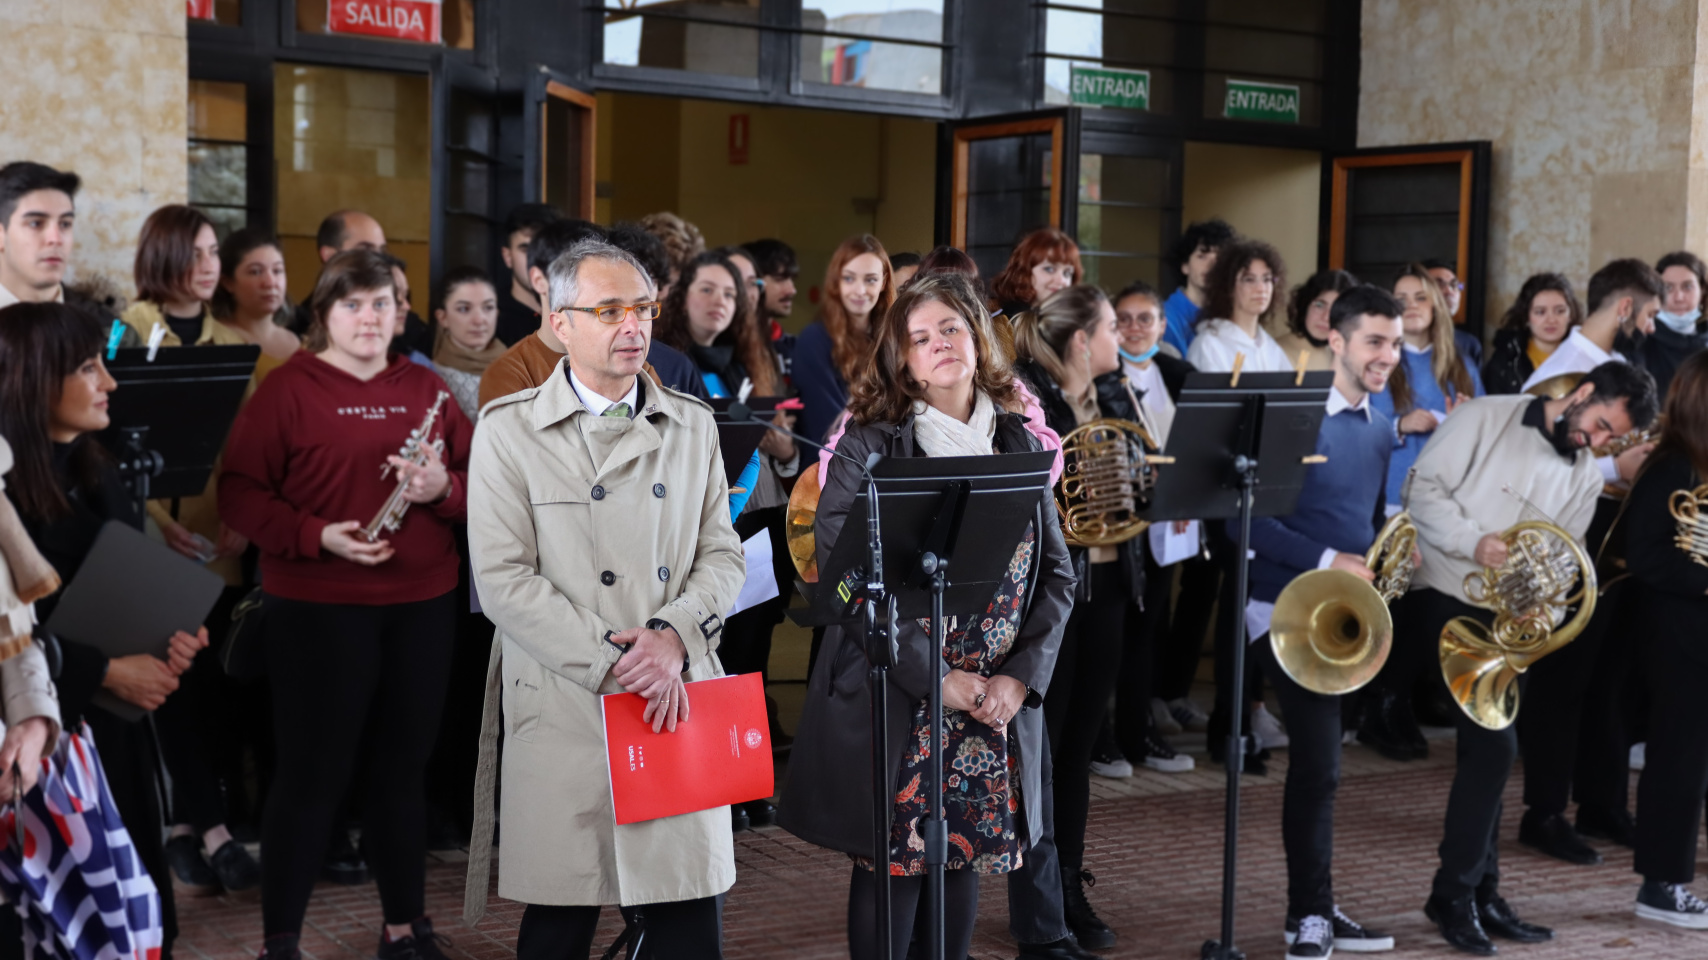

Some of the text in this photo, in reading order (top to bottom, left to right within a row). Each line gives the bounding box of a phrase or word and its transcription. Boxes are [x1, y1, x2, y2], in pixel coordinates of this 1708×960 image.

[345, 1, 425, 32] SALIDA
[1072, 73, 1147, 99] ENTRADA
[1227, 89, 1297, 113] ENTRADA
[370, 406, 386, 414] LA
